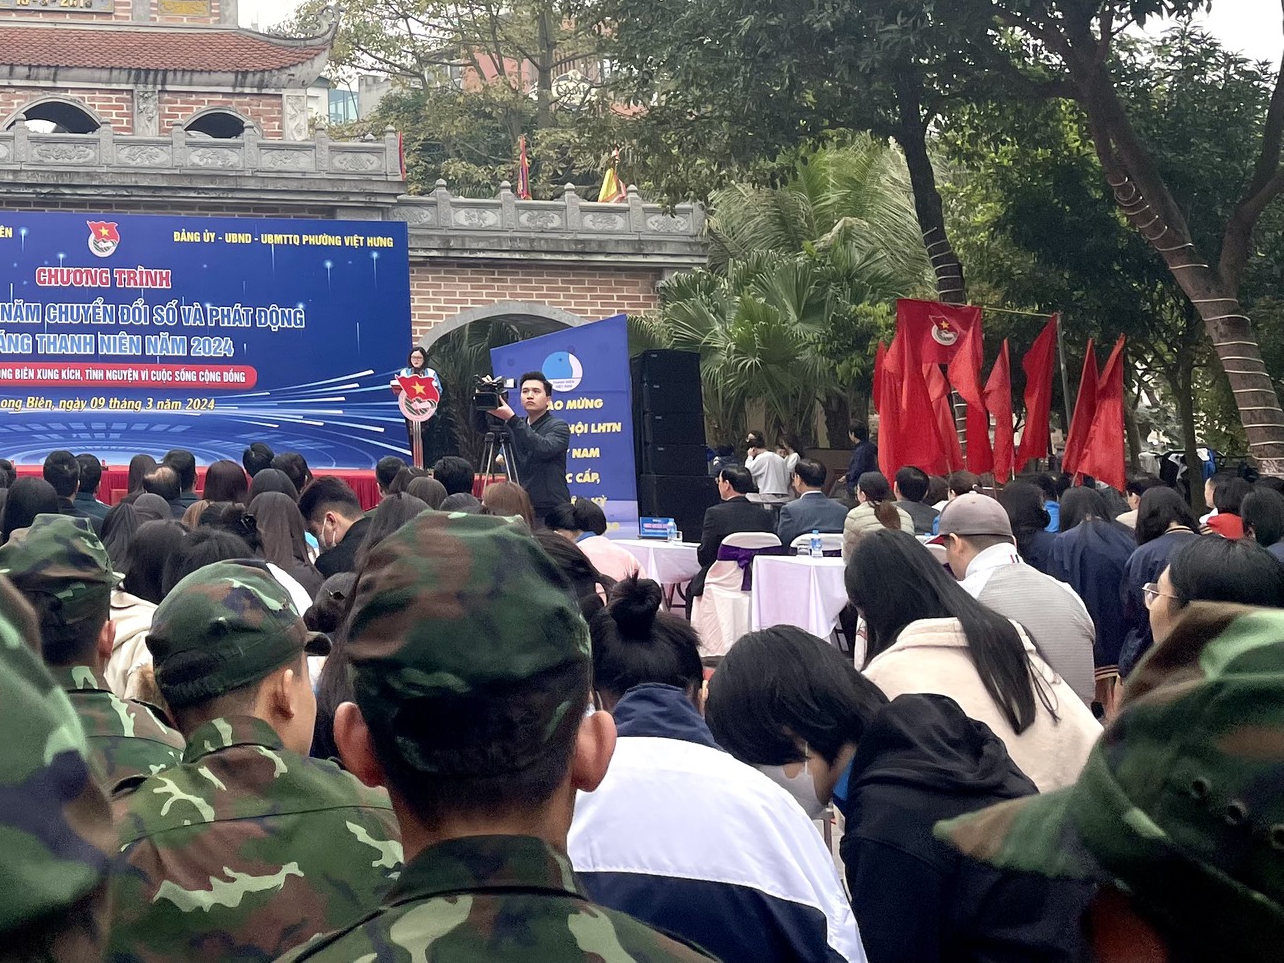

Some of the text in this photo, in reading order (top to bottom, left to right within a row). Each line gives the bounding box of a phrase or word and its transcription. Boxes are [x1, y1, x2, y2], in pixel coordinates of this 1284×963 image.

[173, 227, 201, 243] ĐẢNG
[203, 227, 216, 243] ỦY
[224, 231, 252, 244] UBND
[261, 233, 300, 247] UBMTTQ
[302, 232, 341, 246] PHƯỜNG
[343, 232, 365, 249] VIỆT
[367, 234, 394, 248] HƯNG
[35, 265, 172, 289] CHƯƠNG TRÌNH
[0, 299, 41, 324] NĂM
[45, 296, 114, 325] CHUYỂN
[118, 297, 151, 325] ĐỔI
[153, 299, 177, 325] SỐ
[180, 303, 206, 326] VÀ
[209, 303, 253, 327] PHÁT
[256, 304, 305, 332] ĐỘNG
[37, 334, 94, 355] THANH
[98, 330, 142, 356] NIÊN
[145, 331, 187, 357] NĂM
[190, 336, 234, 357] 2024
[15, 367, 34, 380] BIÊN
[37, 369, 59, 381] XUNG
[61, 367, 83, 382] KÍCH,
[85, 367, 104, 381] TÌNH
[106, 368, 140, 384] NGUYỆN
[142, 367, 149, 381] VÌ
[151, 368, 173, 384] CUỘC
[175, 367, 198, 382] SỐNG
[200, 369, 221, 385] CỘNG
[223, 368, 246, 383] ĐỒNG
[26, 396, 55, 411] Biên,
[58, 397, 88, 413] ngày
[90, 398, 106, 410] 09
[108, 397, 142, 413] tháng
[145, 398, 153, 410] 3
[156, 399, 182, 411] năm
[185, 398, 216, 411] 2024
[566, 396, 604, 410] MỪNG
[591, 422, 622, 433] LHTN
[572, 447, 600, 458] NAM
[575, 468, 601, 484] CẤP,
